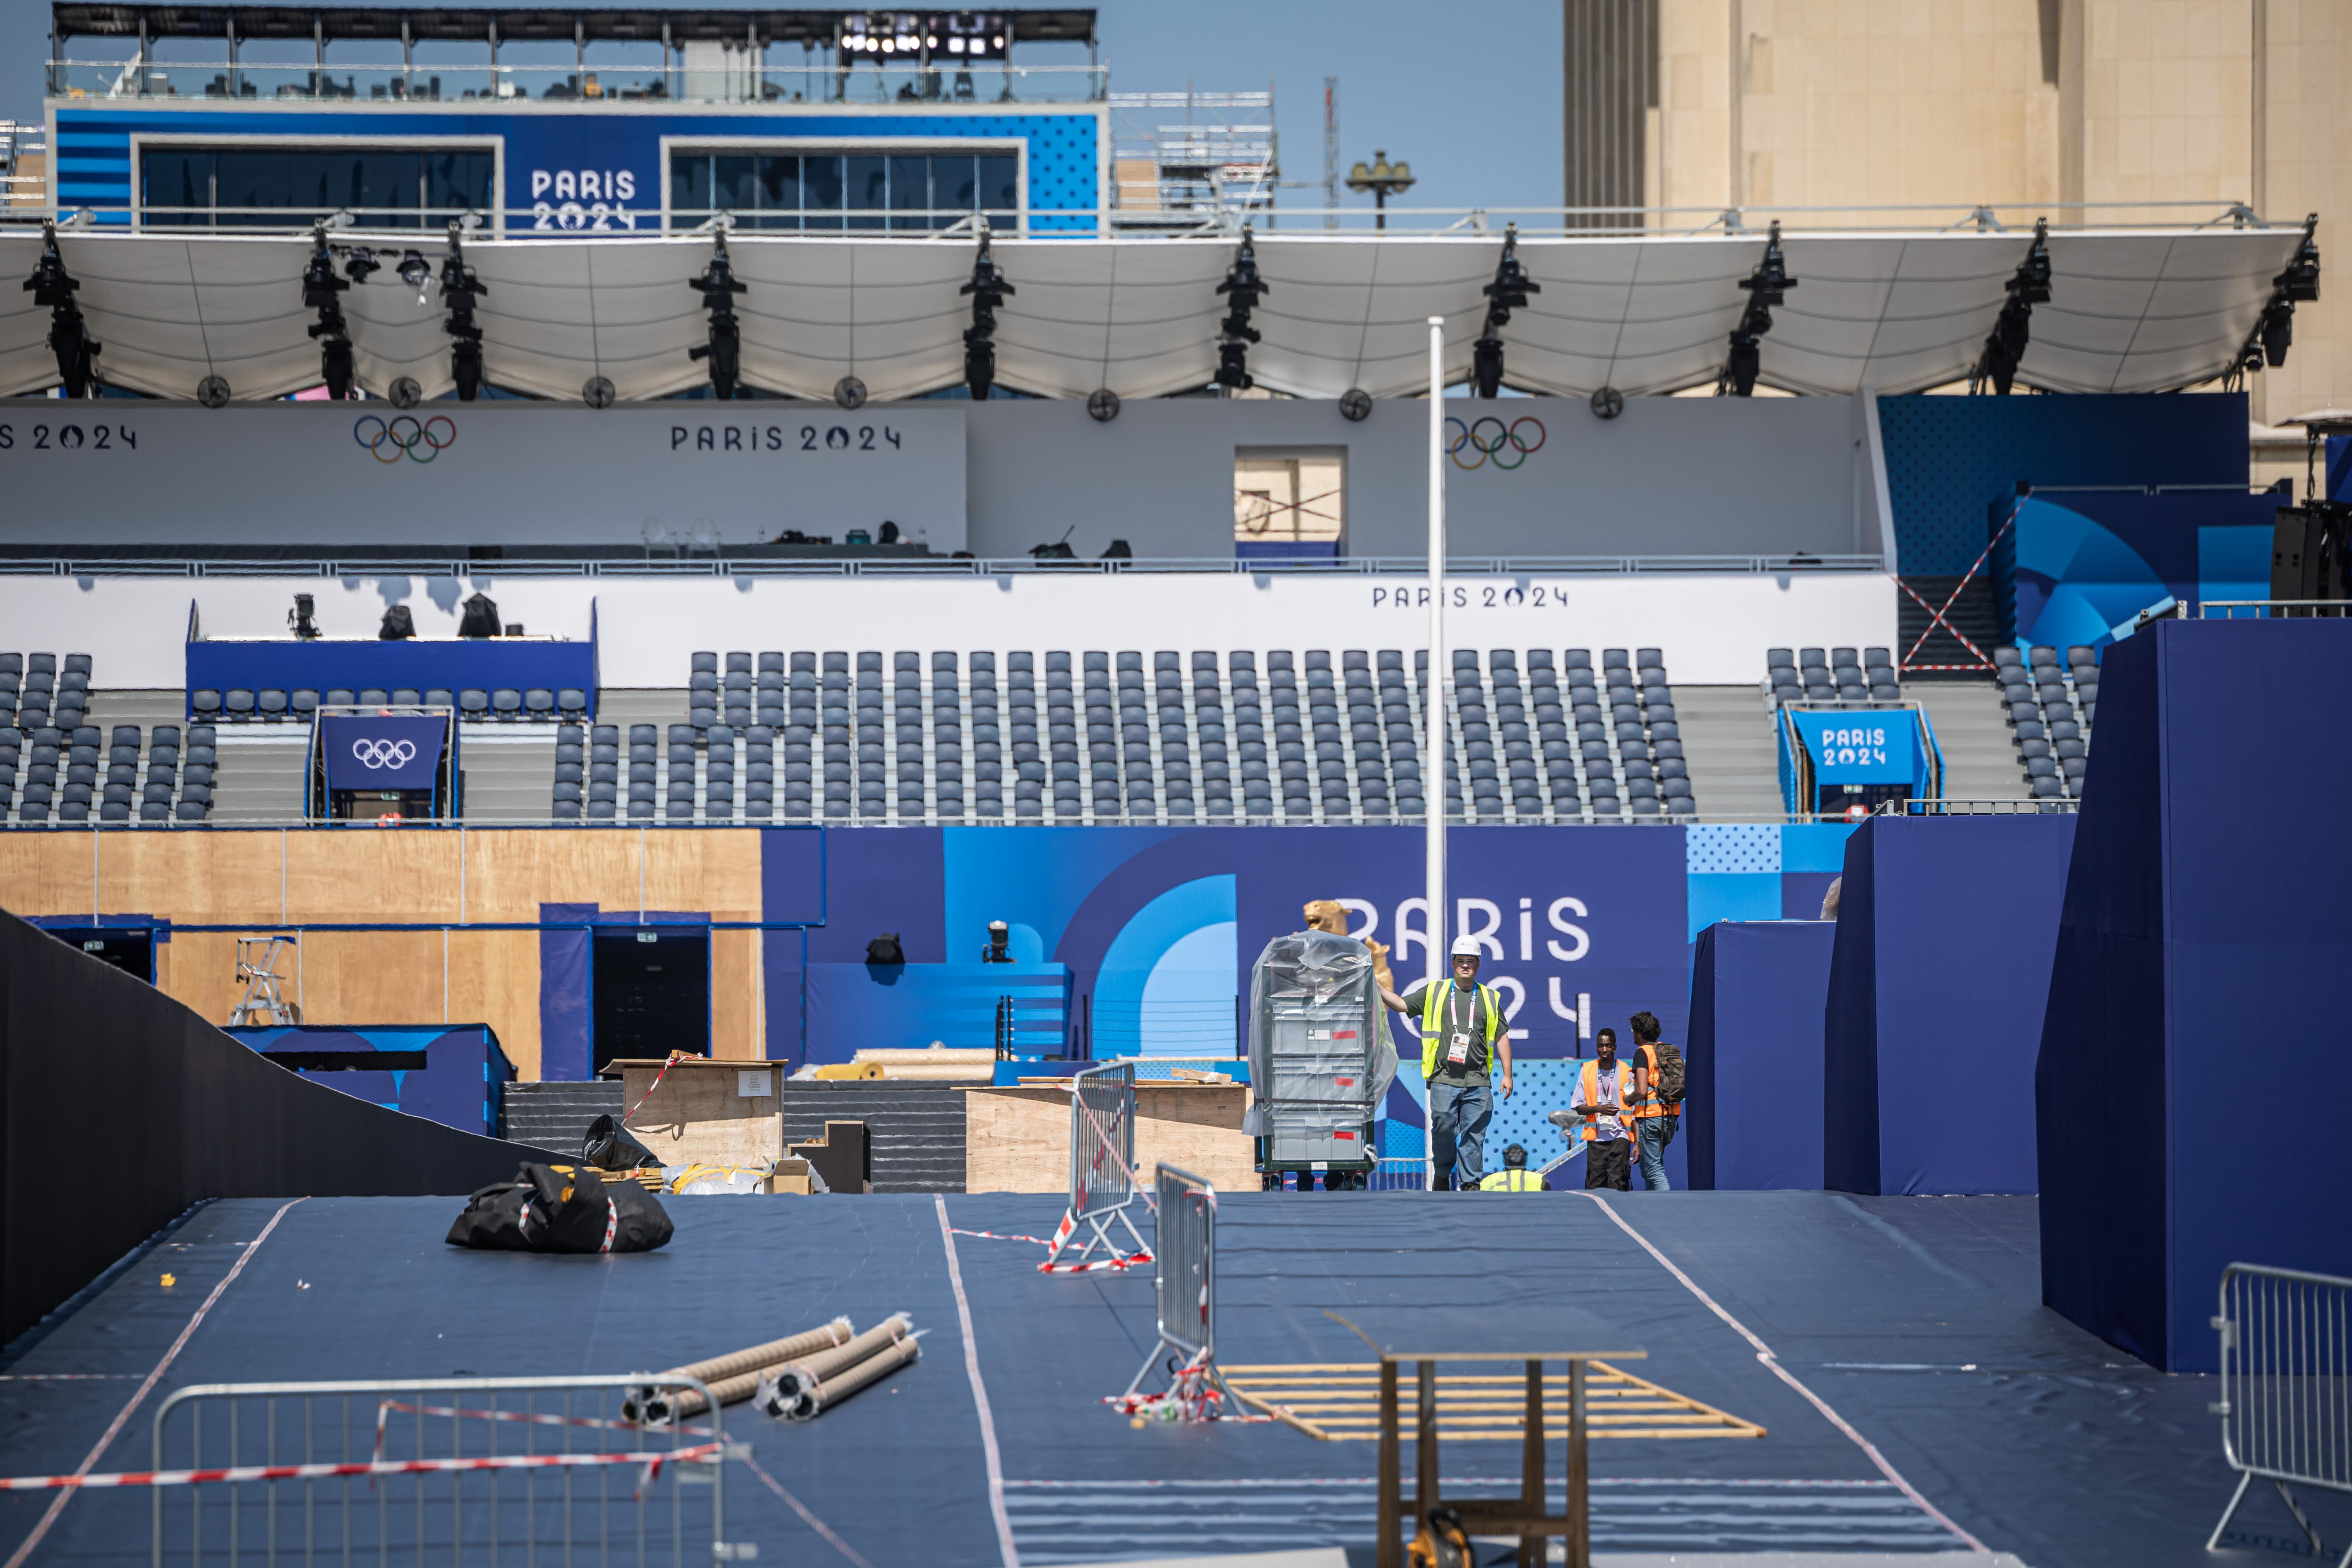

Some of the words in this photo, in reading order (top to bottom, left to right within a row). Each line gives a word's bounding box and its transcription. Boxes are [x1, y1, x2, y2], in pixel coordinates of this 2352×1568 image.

[533, 201, 636, 231] 2024
[33, 424, 136, 449] 2024
[801, 426, 901, 450] 2024
[1482, 587, 1567, 607] 2024
[1823, 748, 1886, 766] 2024
